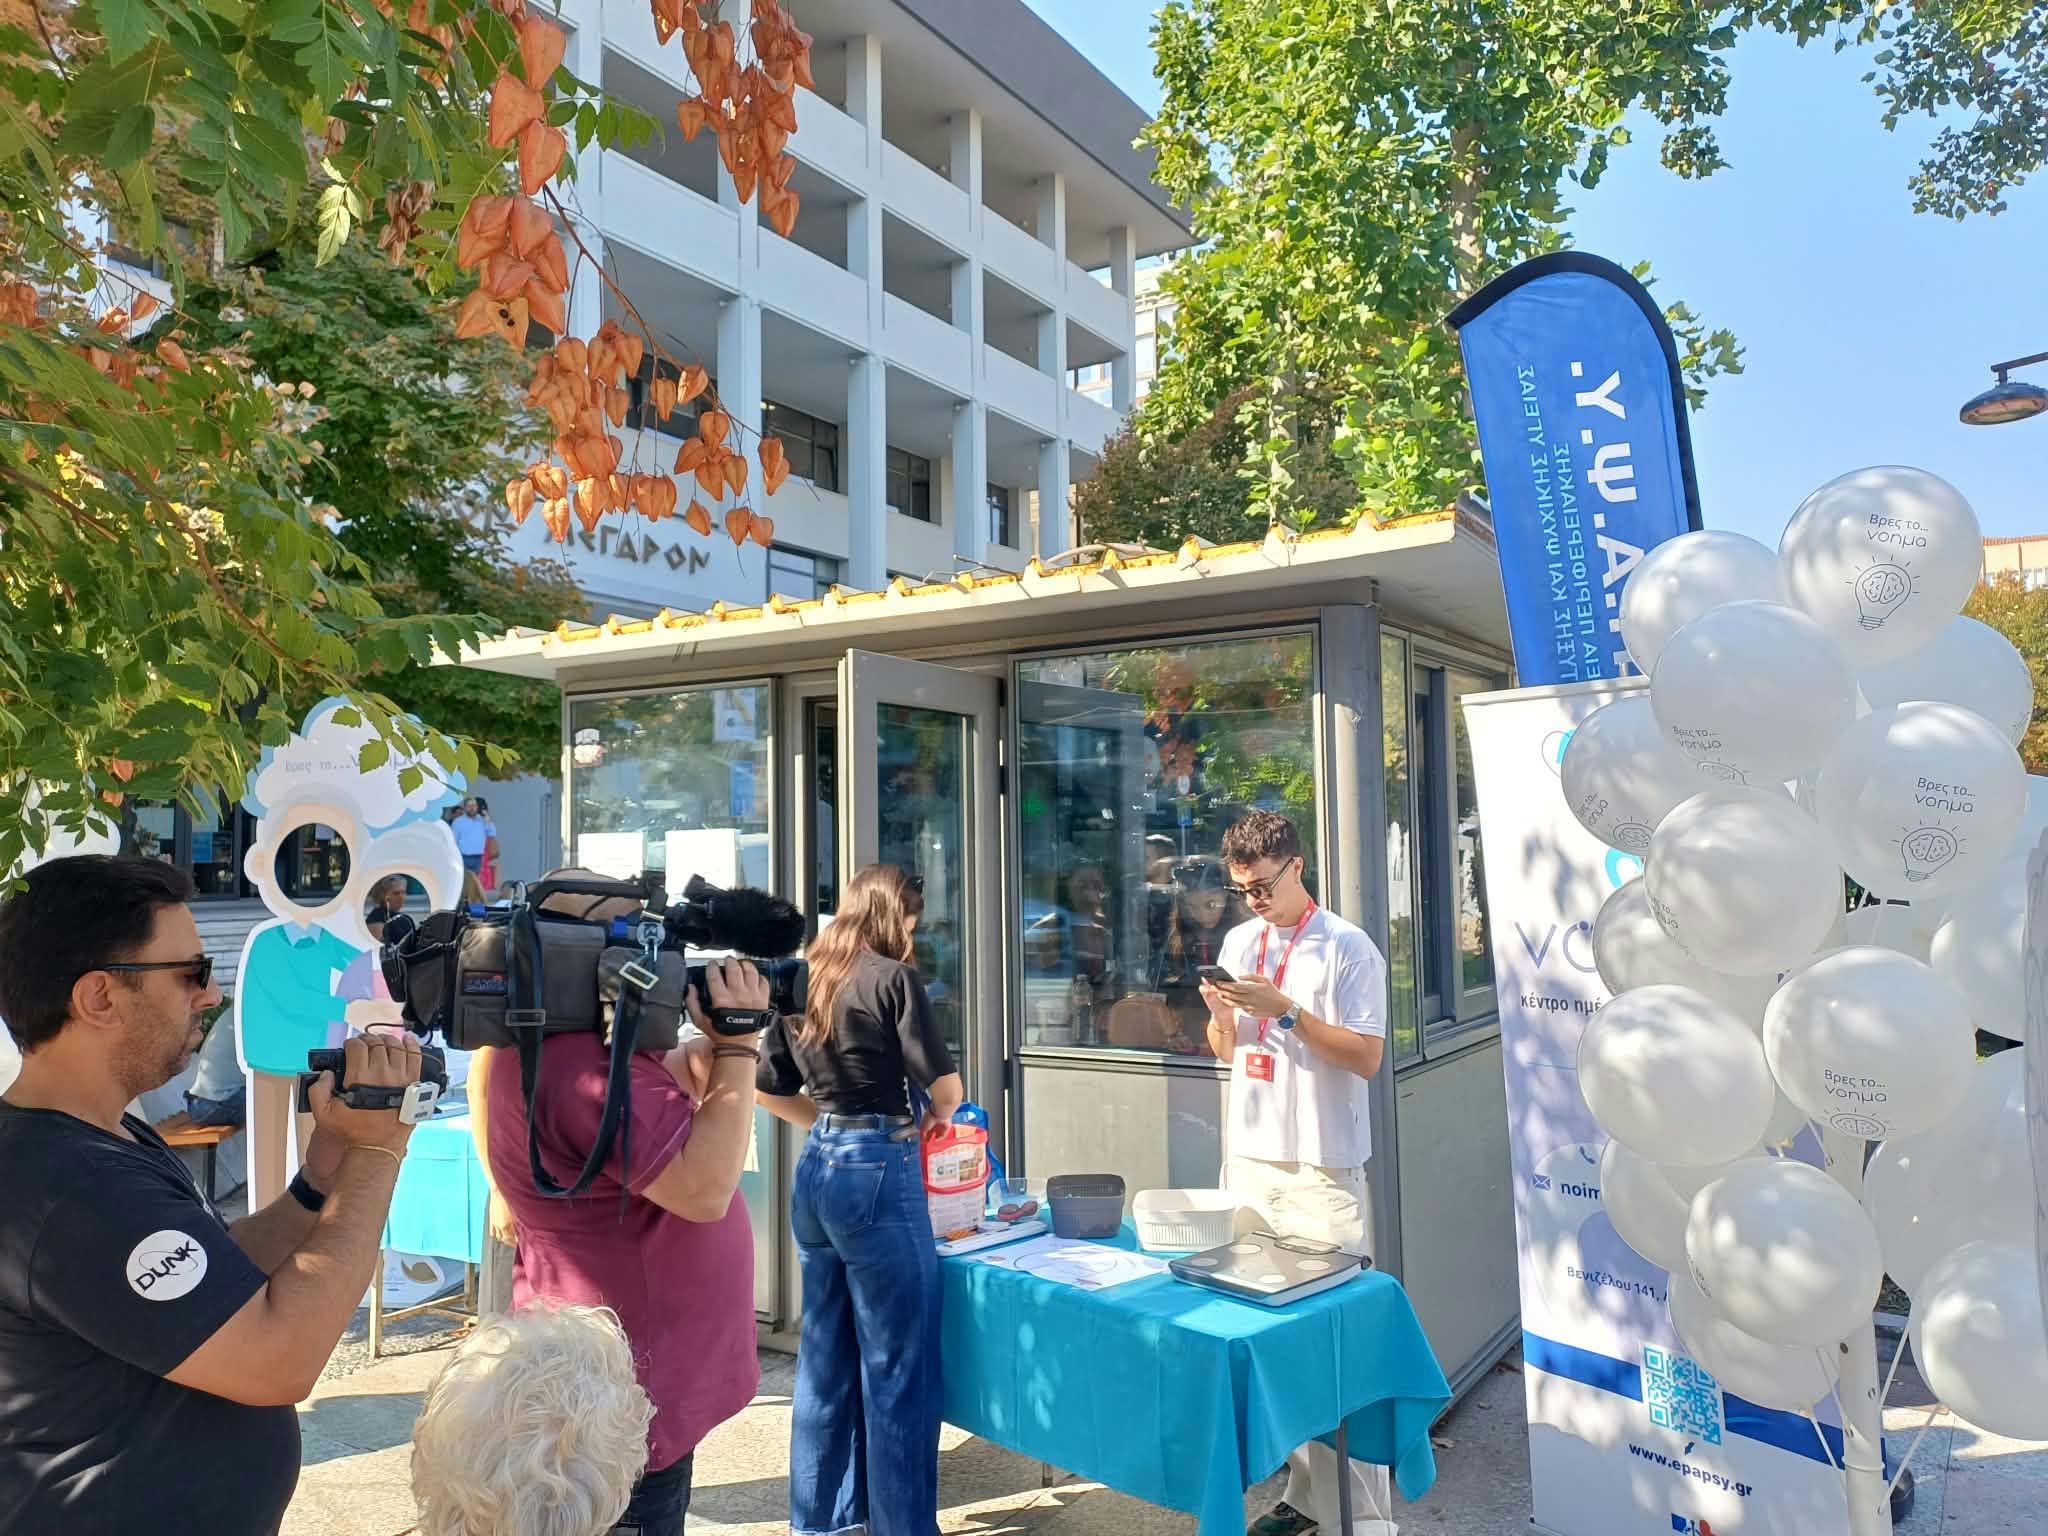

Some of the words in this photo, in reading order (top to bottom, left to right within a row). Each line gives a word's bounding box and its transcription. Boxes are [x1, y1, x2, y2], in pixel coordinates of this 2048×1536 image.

[1520, 991, 1569, 1014] κέντρο
[1573, 996, 1603, 1016] ημέ
[1559, 1182, 1601, 1200] noim
[133, 1239, 200, 1291] DUNK
[1627, 1442, 1754, 1498] www.epapsy.gr
